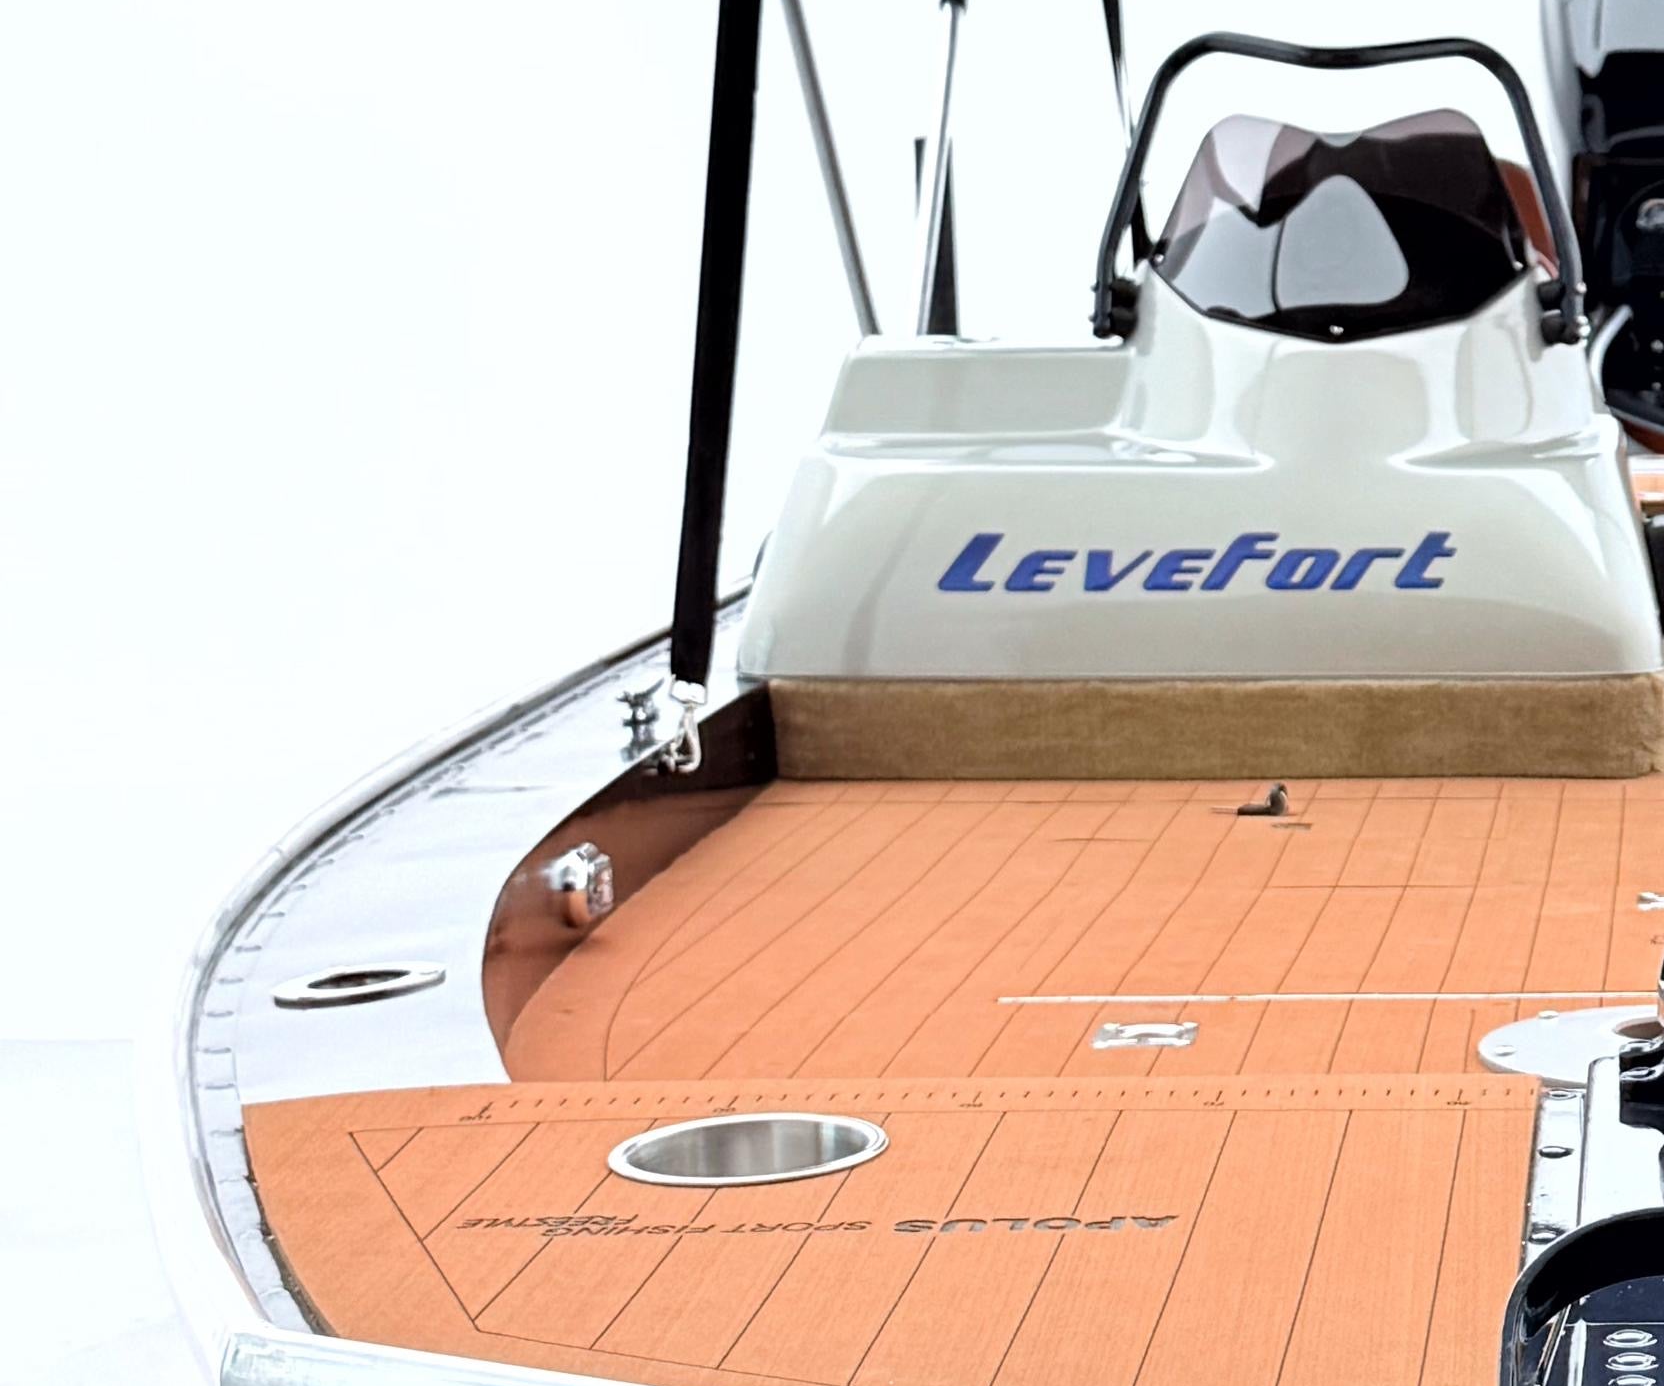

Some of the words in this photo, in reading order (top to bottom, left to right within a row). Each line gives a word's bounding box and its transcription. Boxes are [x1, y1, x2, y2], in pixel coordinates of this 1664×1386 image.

[937, 532, 1457, 592] Levefort
[541, 1224, 717, 1237] FISHING
[720, 1220, 873, 1234] SPORT
[894, 1215, 1179, 1233] APOLUS
